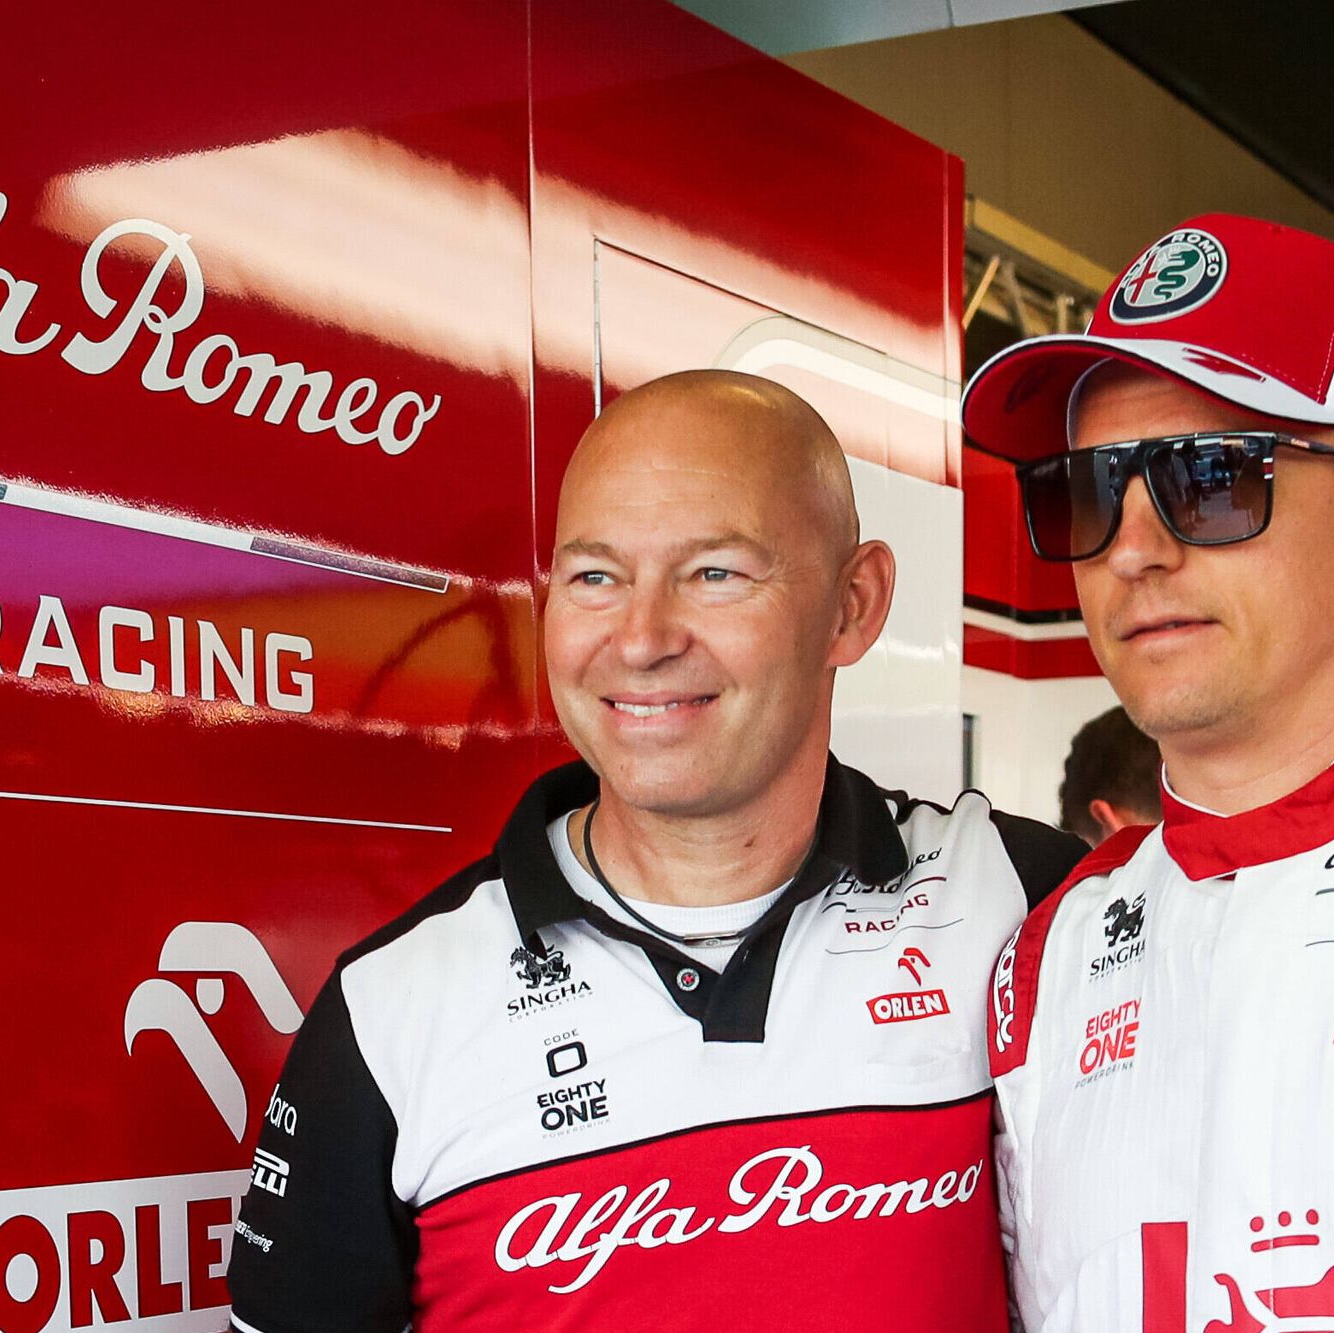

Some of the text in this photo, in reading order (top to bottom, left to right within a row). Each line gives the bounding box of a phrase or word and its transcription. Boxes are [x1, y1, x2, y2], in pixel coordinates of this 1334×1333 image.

[1171, 233, 1220, 277] ROMEO
[61, 218, 441, 456] Romeo
[1089, 938, 1146, 977] SINGHA
[507, 981, 592, 1016] SINGHA
[874, 993, 945, 1021] ORLEN
[1086, 996, 1143, 1039] EIGHTY
[1079, 1020, 1140, 1076] ONE
[536, 1079, 607, 1109] EIGHTY
[540, 1095, 610, 1132] ONE
[495, 1144, 984, 1294] Alfa Romeo
